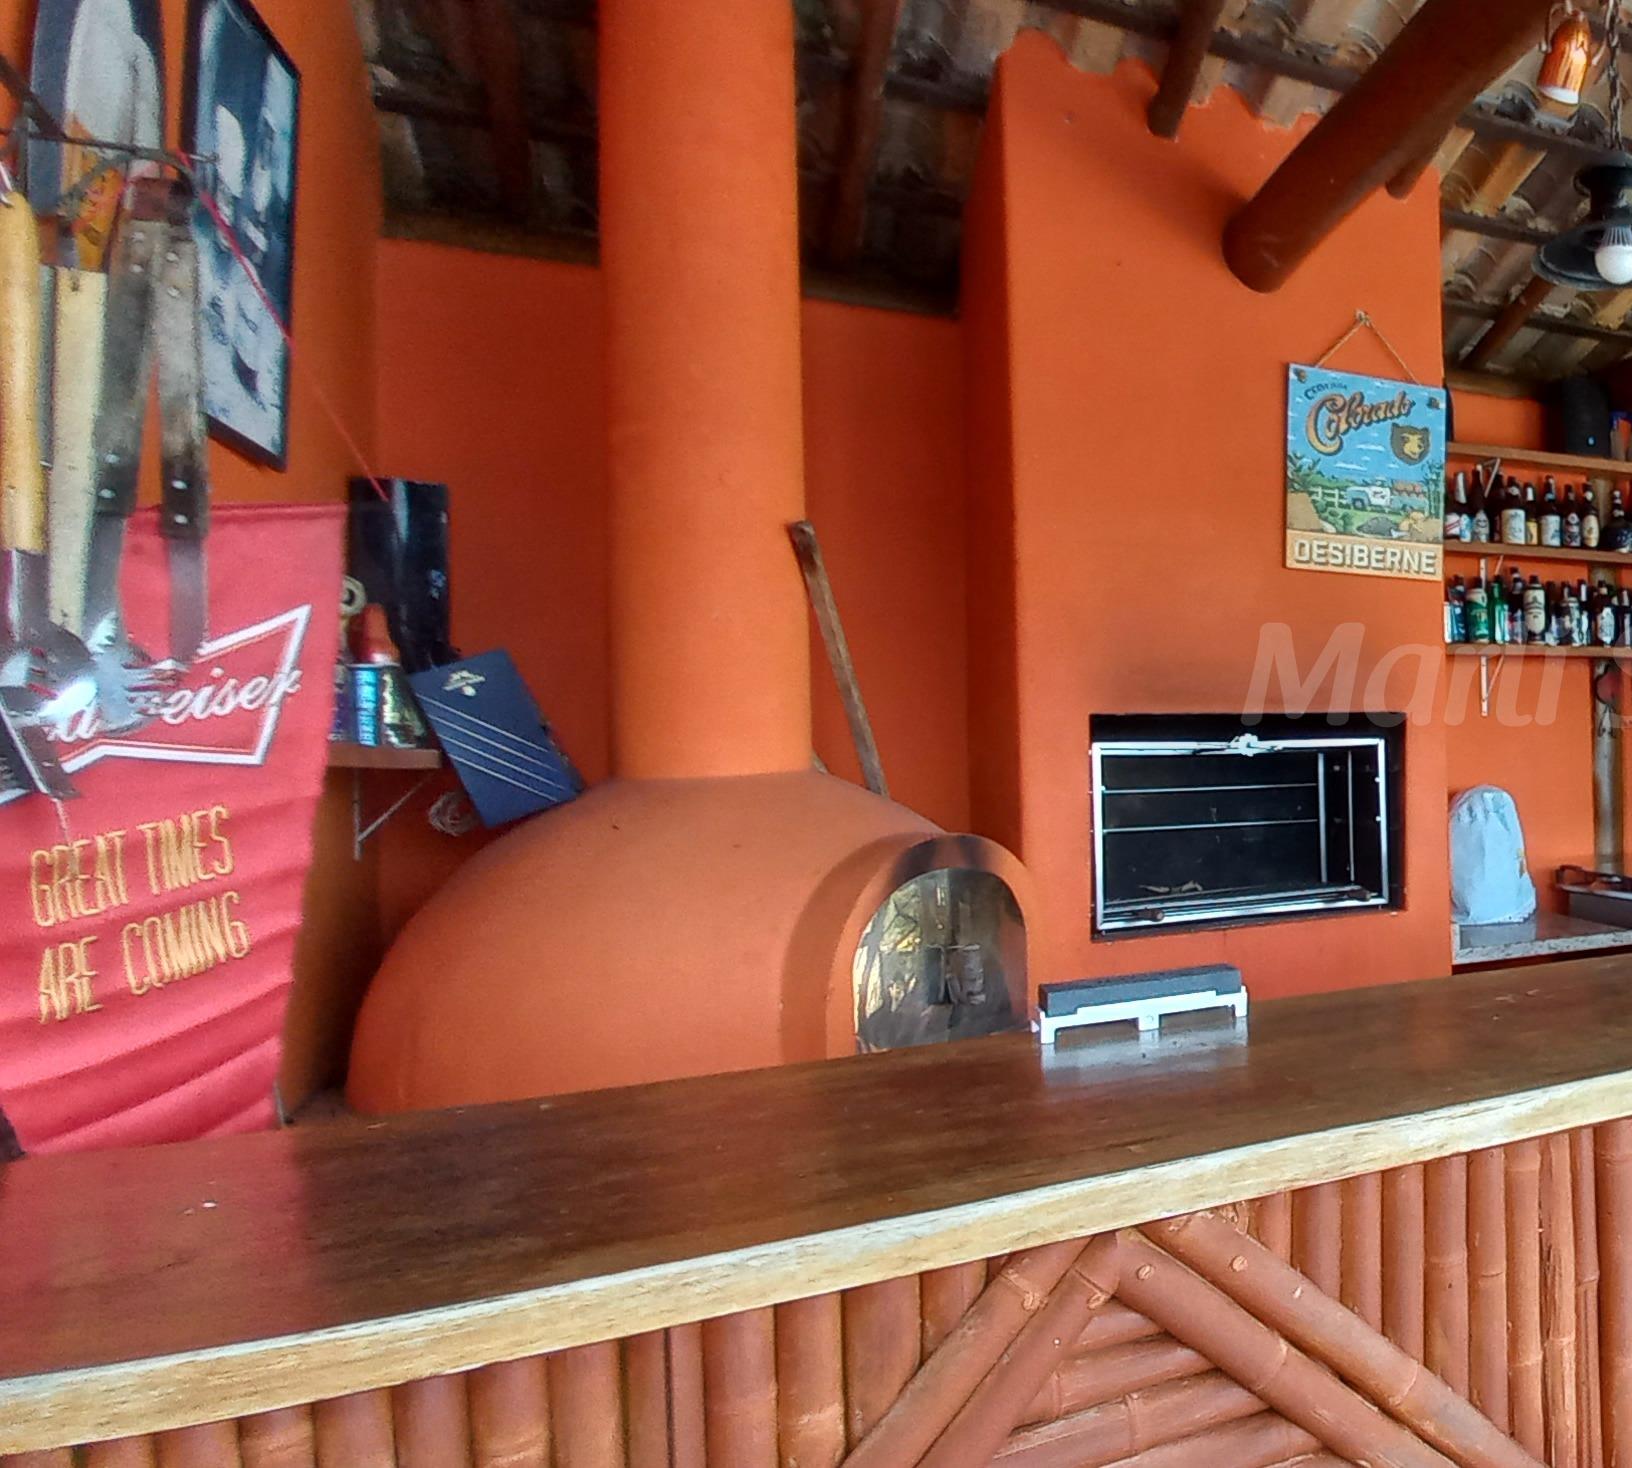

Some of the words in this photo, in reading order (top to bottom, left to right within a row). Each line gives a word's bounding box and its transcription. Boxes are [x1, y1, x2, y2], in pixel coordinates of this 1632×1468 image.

[31, 830, 129, 926] GREAT
[136, 805, 234, 895] TIMES
[39, 936, 104, 1024] ARE
[121, 891, 250, 994] COMING
